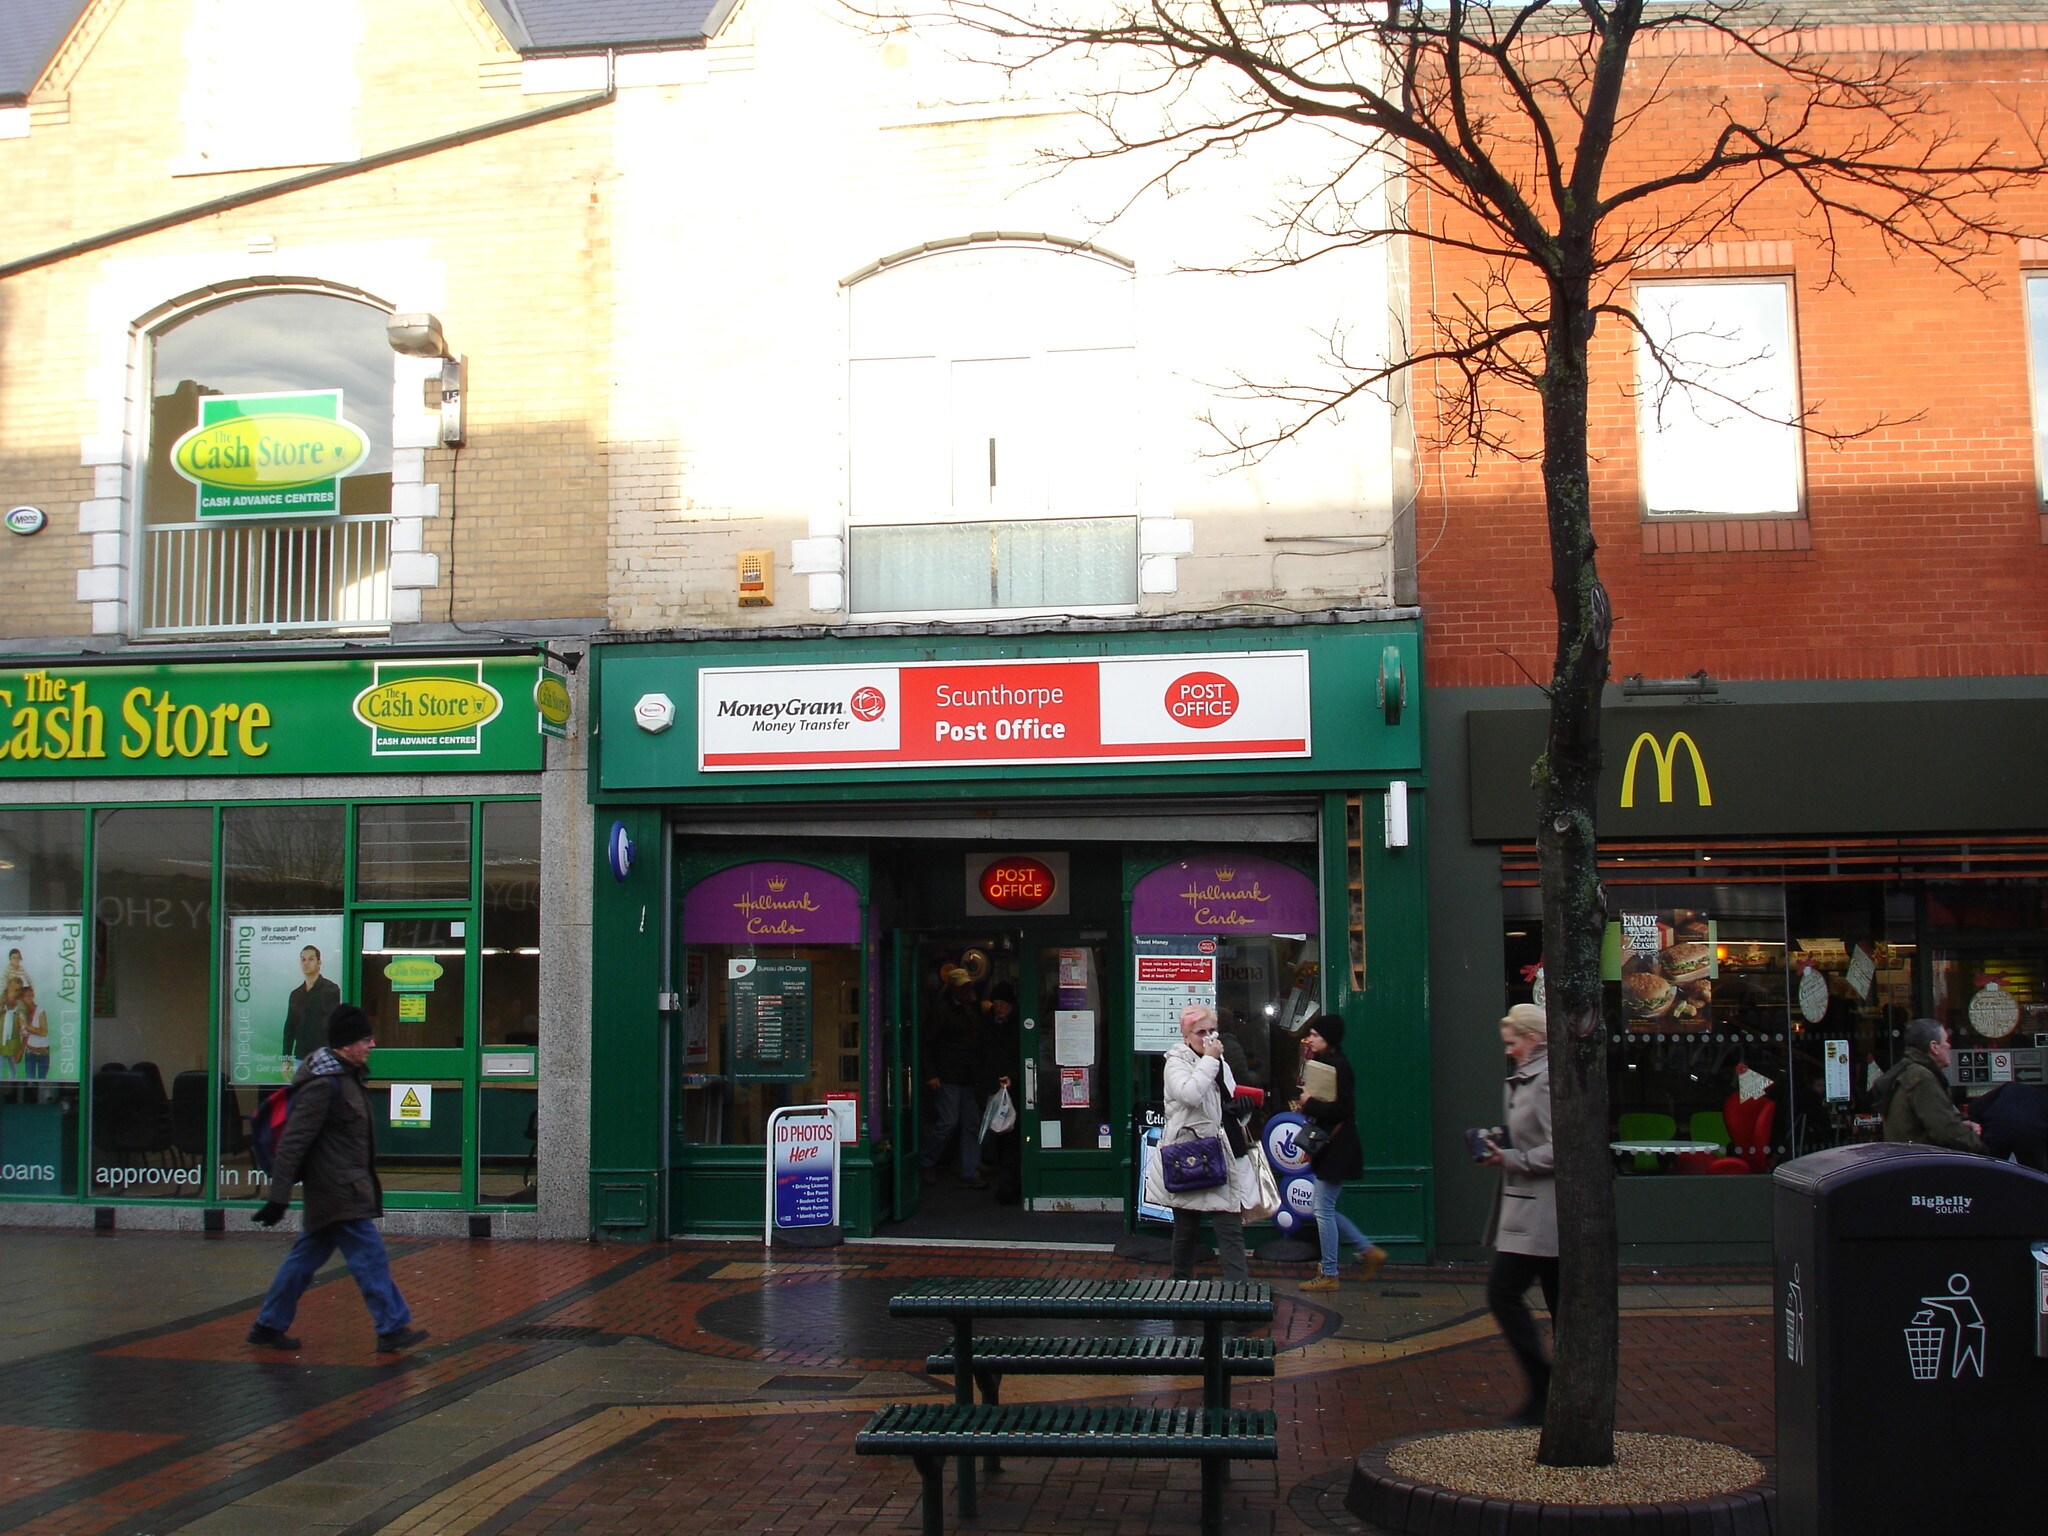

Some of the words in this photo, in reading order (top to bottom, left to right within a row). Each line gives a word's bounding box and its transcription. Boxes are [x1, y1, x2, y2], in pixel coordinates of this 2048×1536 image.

[214, 430, 232, 443] The
[191, 435, 251, 470] Cash
[258, 436, 325, 467] Store
[202, 497, 230, 508] CASH
[233, 494, 283, 506] ADVANCE
[284, 492, 334, 504] CENTRES
[24, 669, 67, 702] The
[385, 688, 400, 698] The
[1180, 683, 1226, 700] POST
[368, 691, 414, 717] Cash
[419, 693, 469, 717] Store
[936, 684, 1064, 708] Scunthorpe
[717, 698, 843, 720] MoneyGram
[1172, 699, 1232, 718] OFFICE
[121, 686, 271, 758] Store
[752, 719, 796, 735] Money
[799, 718, 851, 731] Transfer
[935, 720, 987, 742] Post
[995, 718, 1066, 741] Office
[377, 737, 399, 745] CASH
[400, 736, 438, 745] ADVANCE
[439, 736, 476, 744] CENTRES
[996, 868, 1036, 882] POST
[990, 884, 1042, 897] OFFICE
[1179, 881, 1271, 909] Hallmark
[733, 891, 820, 918] Hallmark
[746, 917, 805, 935] Cards
[1194, 908, 1256, 925] Cards
[1622, 915, 1658, 927] ENJOY
[58, 922, 81, 1004] Payday
[234, 925, 255, 1003] Cashing
[59, 1010, 76, 1075] Loans
[234, 1008, 254, 1081] Cheque
[777, 1126, 788, 1143] ID
[791, 1124, 833, 1142] PHOTOS
[789, 1145, 819, 1164] Here
[0, 1163, 55, 1181] oans
[96, 1164, 201, 1189] approved
[220, 1164, 239, 1185] in
[1292, 1187, 1312, 1199] Play
[1911, 1195, 1973, 1208] BigBelly
[1935, 1206, 1964, 1214] SOLAR
